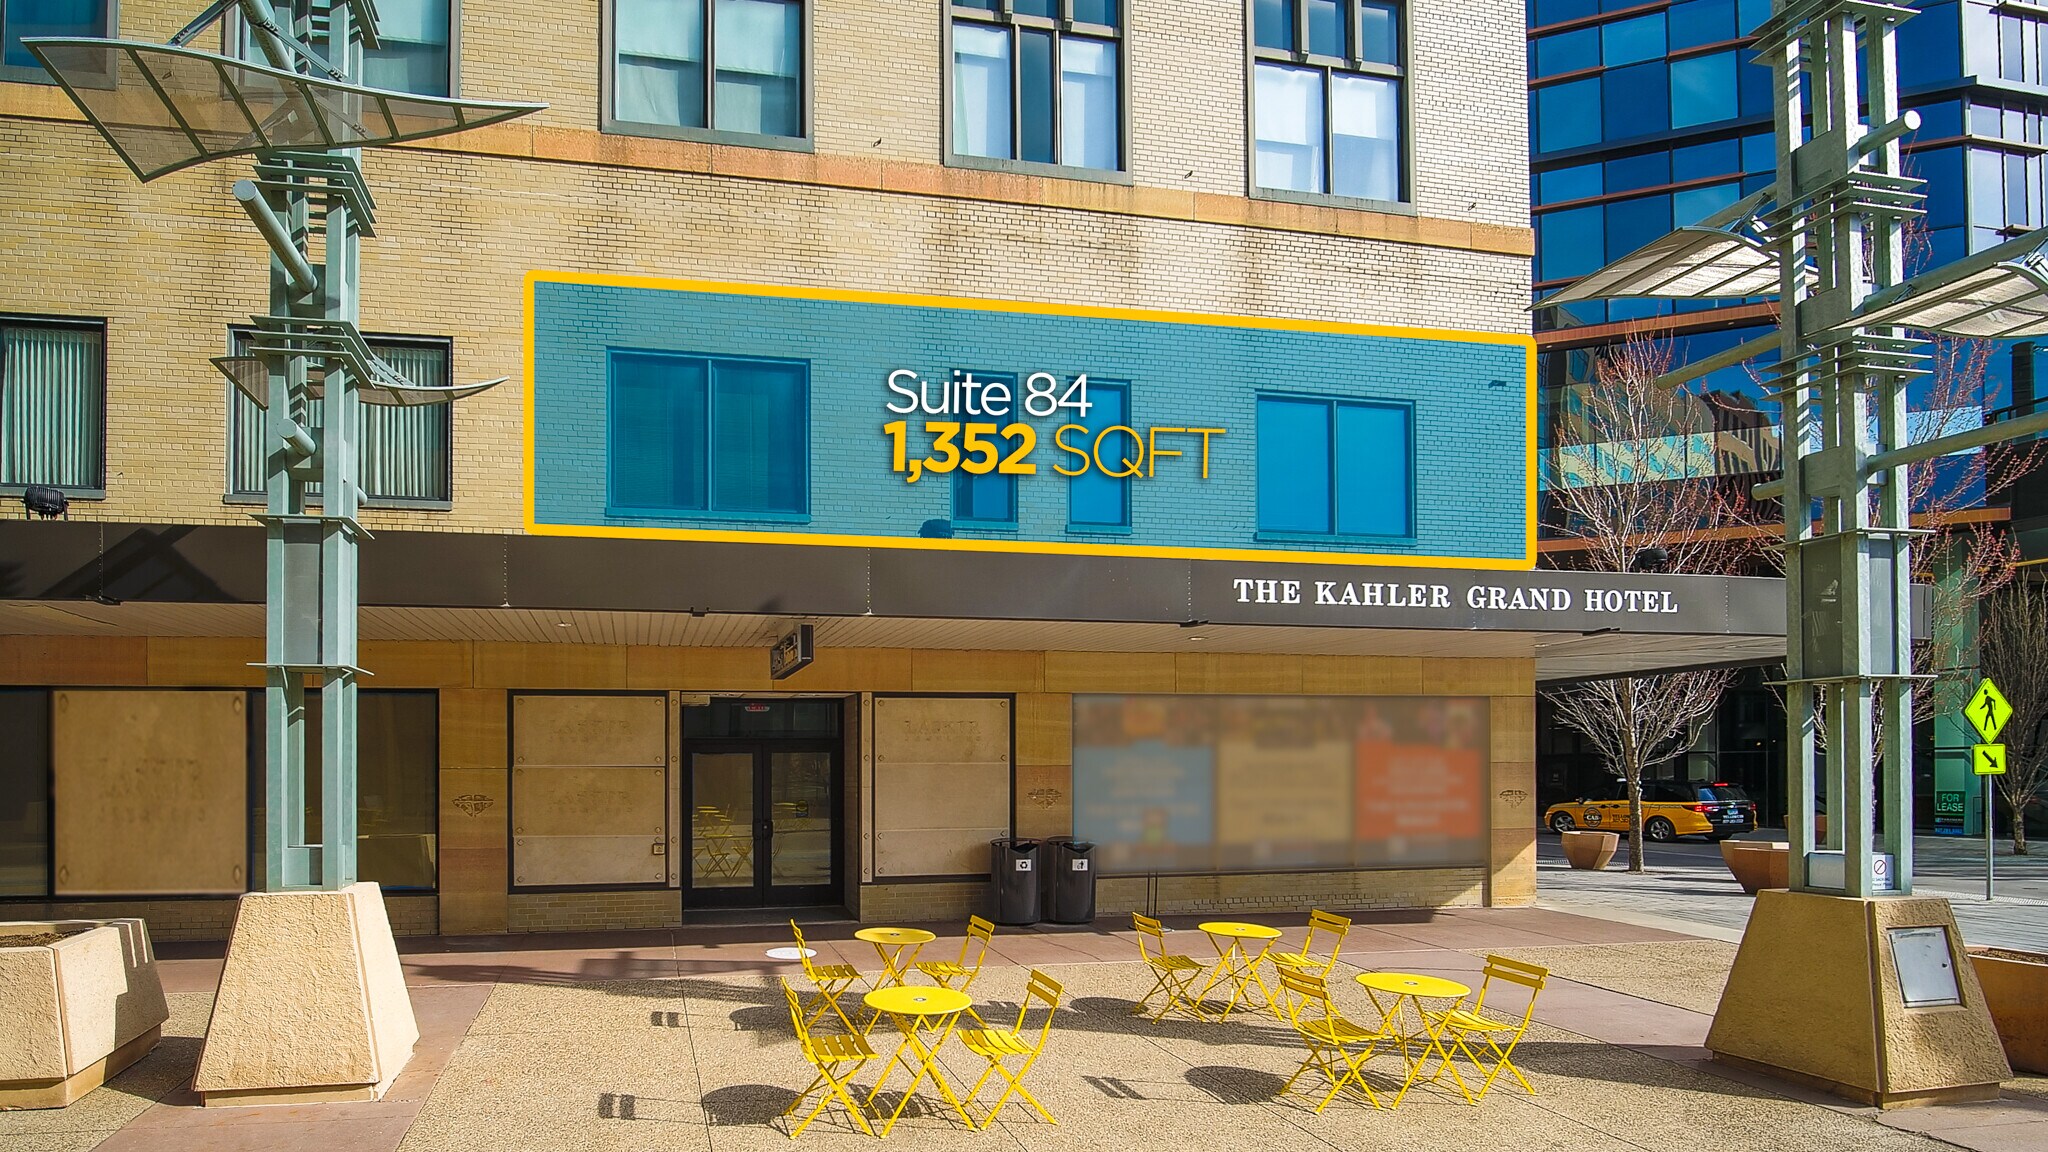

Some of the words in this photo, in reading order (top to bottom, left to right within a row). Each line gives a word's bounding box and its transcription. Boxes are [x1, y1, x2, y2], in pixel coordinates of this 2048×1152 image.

[1233, 578, 1301, 604] THE
[1314, 581, 1451, 608] KAHLER
[1466, 585, 1572, 611] GRAND
[1584, 589, 1678, 613] HOTEL
[1941, 793, 1960, 802] FOR
[1936, 802, 1964, 812] LEASE
